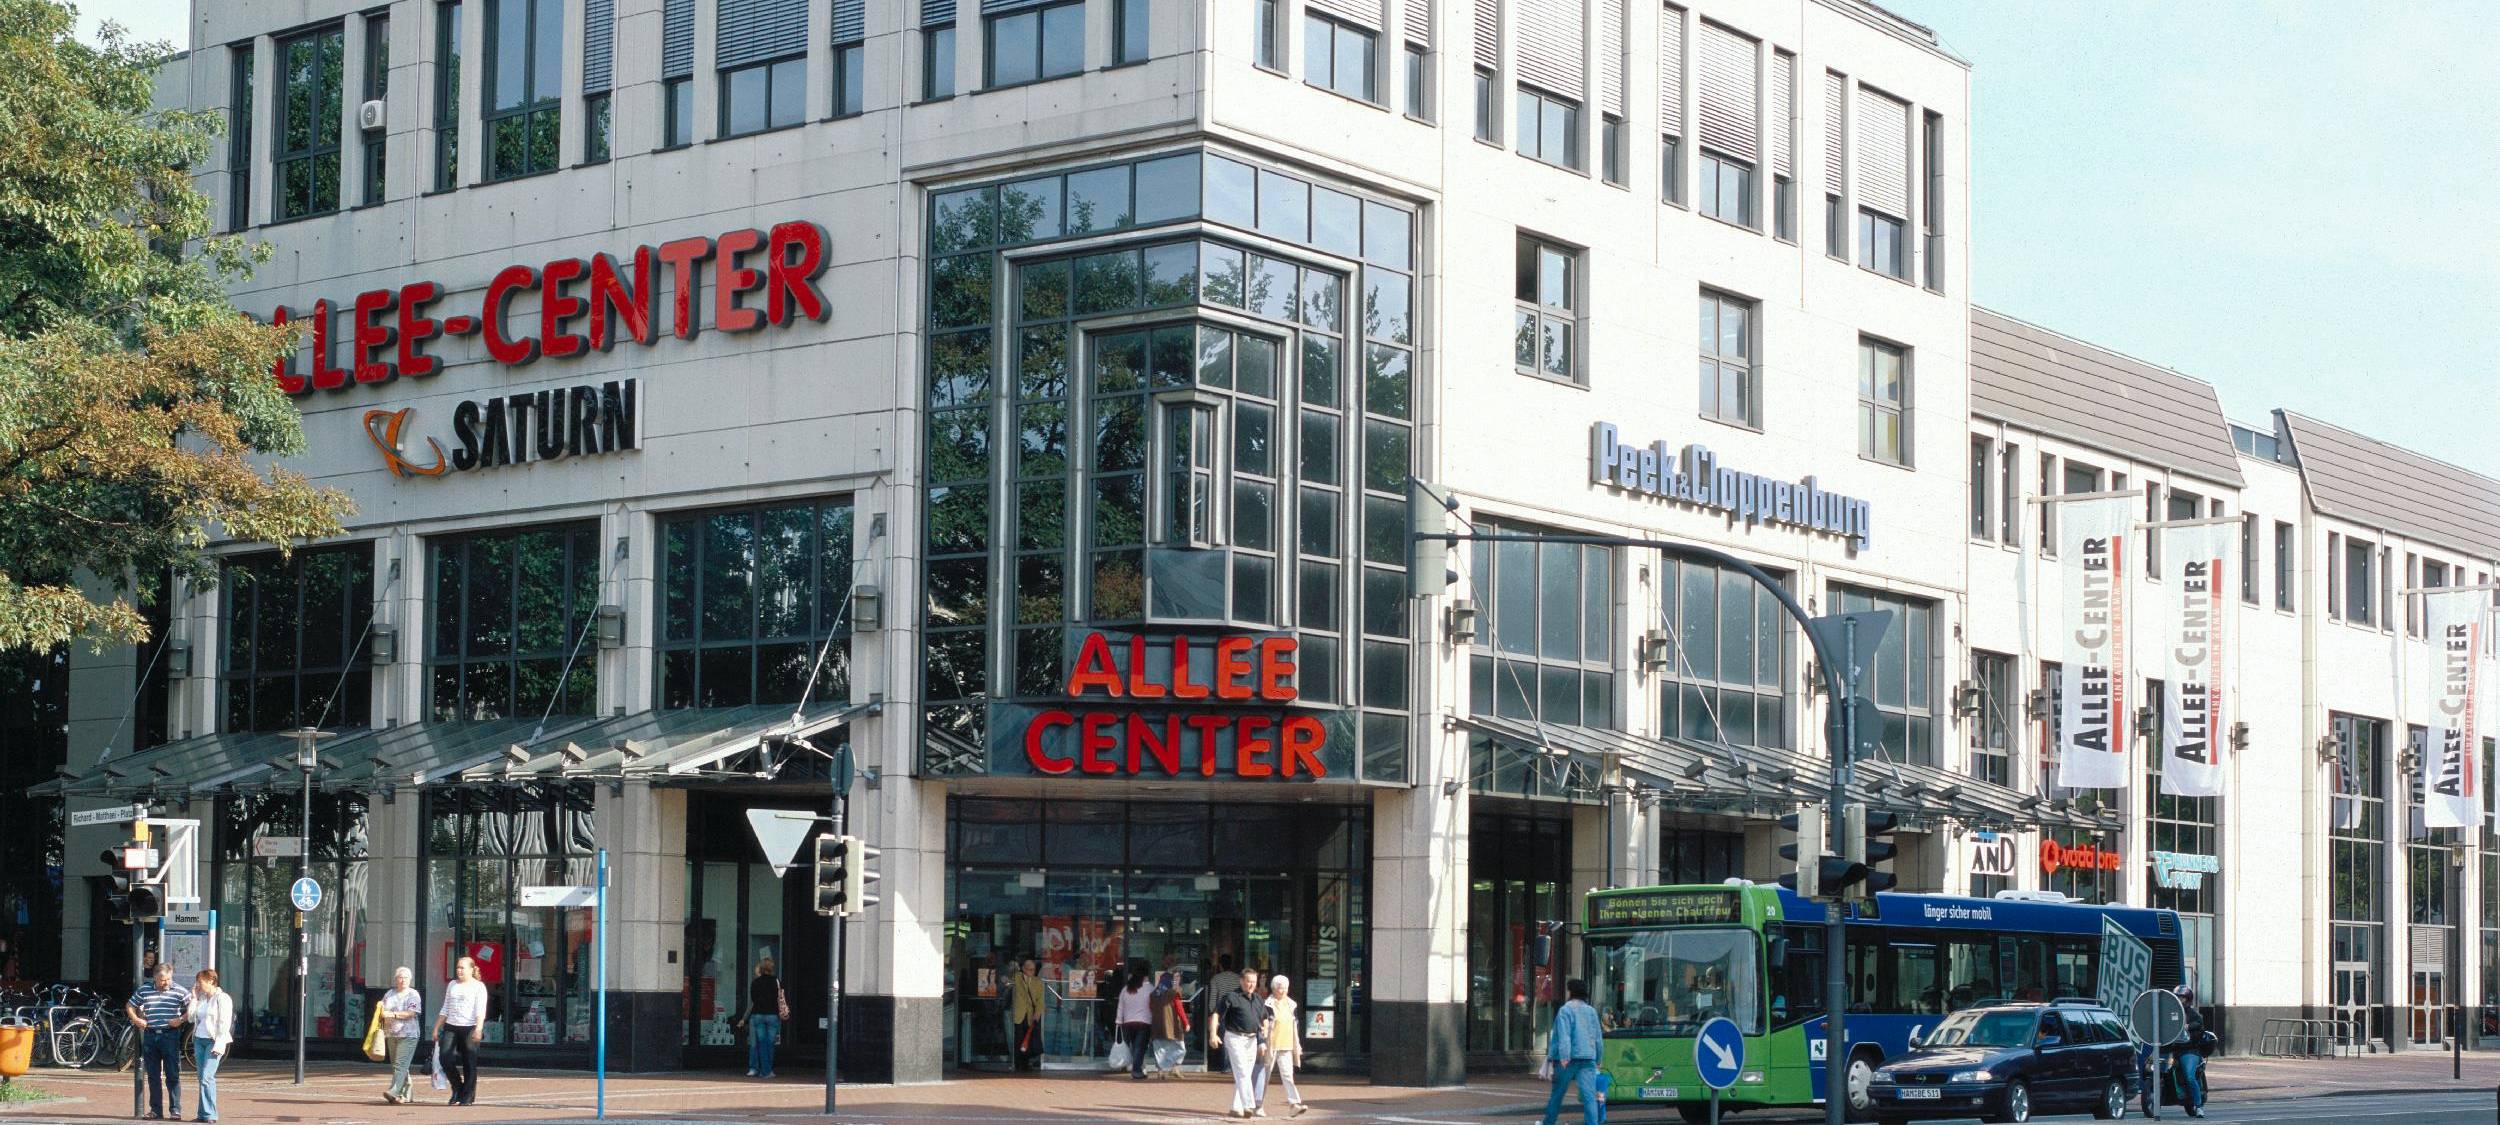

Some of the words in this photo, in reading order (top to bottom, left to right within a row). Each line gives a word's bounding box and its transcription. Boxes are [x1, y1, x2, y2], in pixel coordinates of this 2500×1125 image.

[240, 219, 832, 394] LLEE-CENTER
[453, 378, 643, 471] SATURN
[1067, 631, 1298, 700] ALLEE
[2073, 538, 2108, 752] ALLEE-CENTER
[2174, 561, 2208, 764] ALLEE-CENTER
[1025, 710, 1327, 778] CENTER
[2060, 843, 2120, 869] vodaone
[1672, 896, 1693, 905] sich
[1924, 903, 1948, 921] länger
[1949, 904, 1970, 919] sicher
[1972, 906, 1992, 920] mobil
[2104, 962, 2143, 1003] NET
[2107, 930, 2146, 985] BUS
